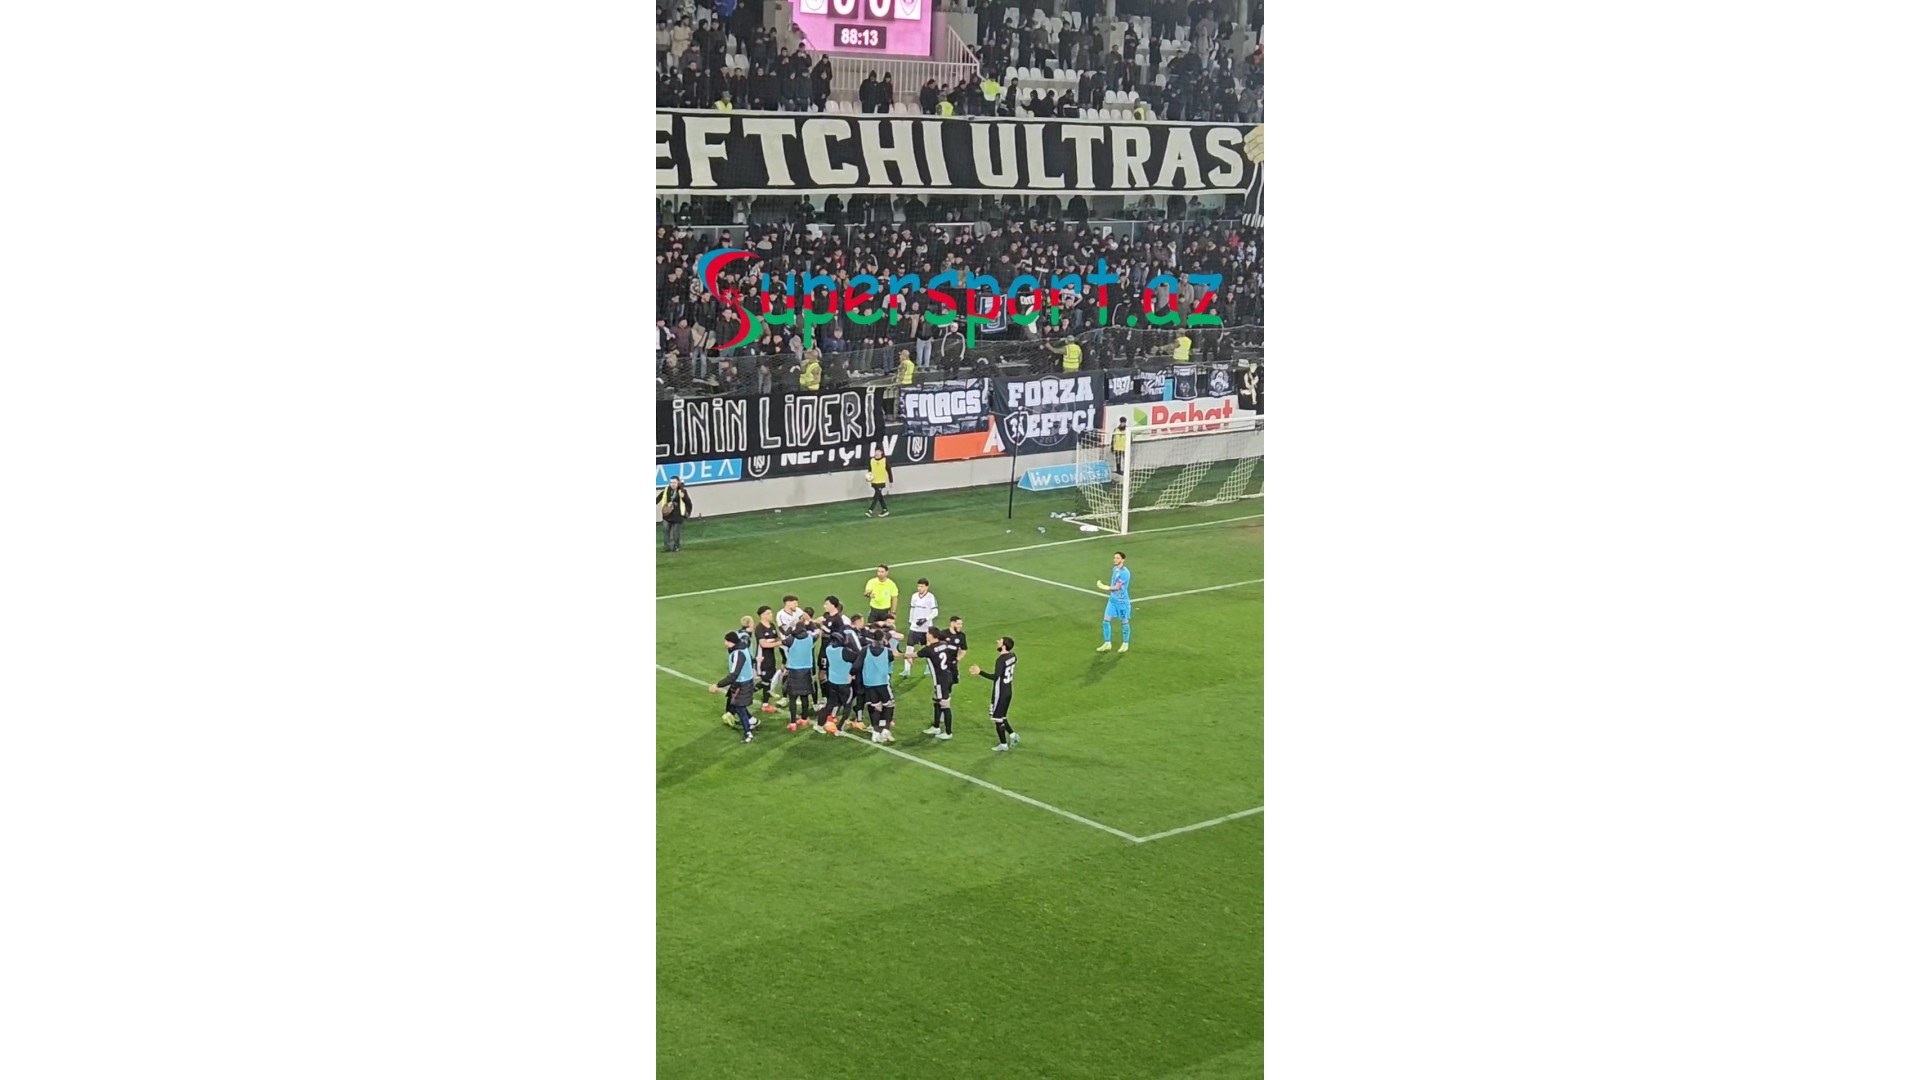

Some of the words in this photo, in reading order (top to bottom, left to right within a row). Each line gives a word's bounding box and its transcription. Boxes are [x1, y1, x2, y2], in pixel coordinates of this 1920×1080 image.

[841, 28, 879, 46] 88:13
[970, 123, 1243, 189] ULTRAS
[1008, 376, 1095, 408] FORZA
[938, 652, 948, 670] 2
